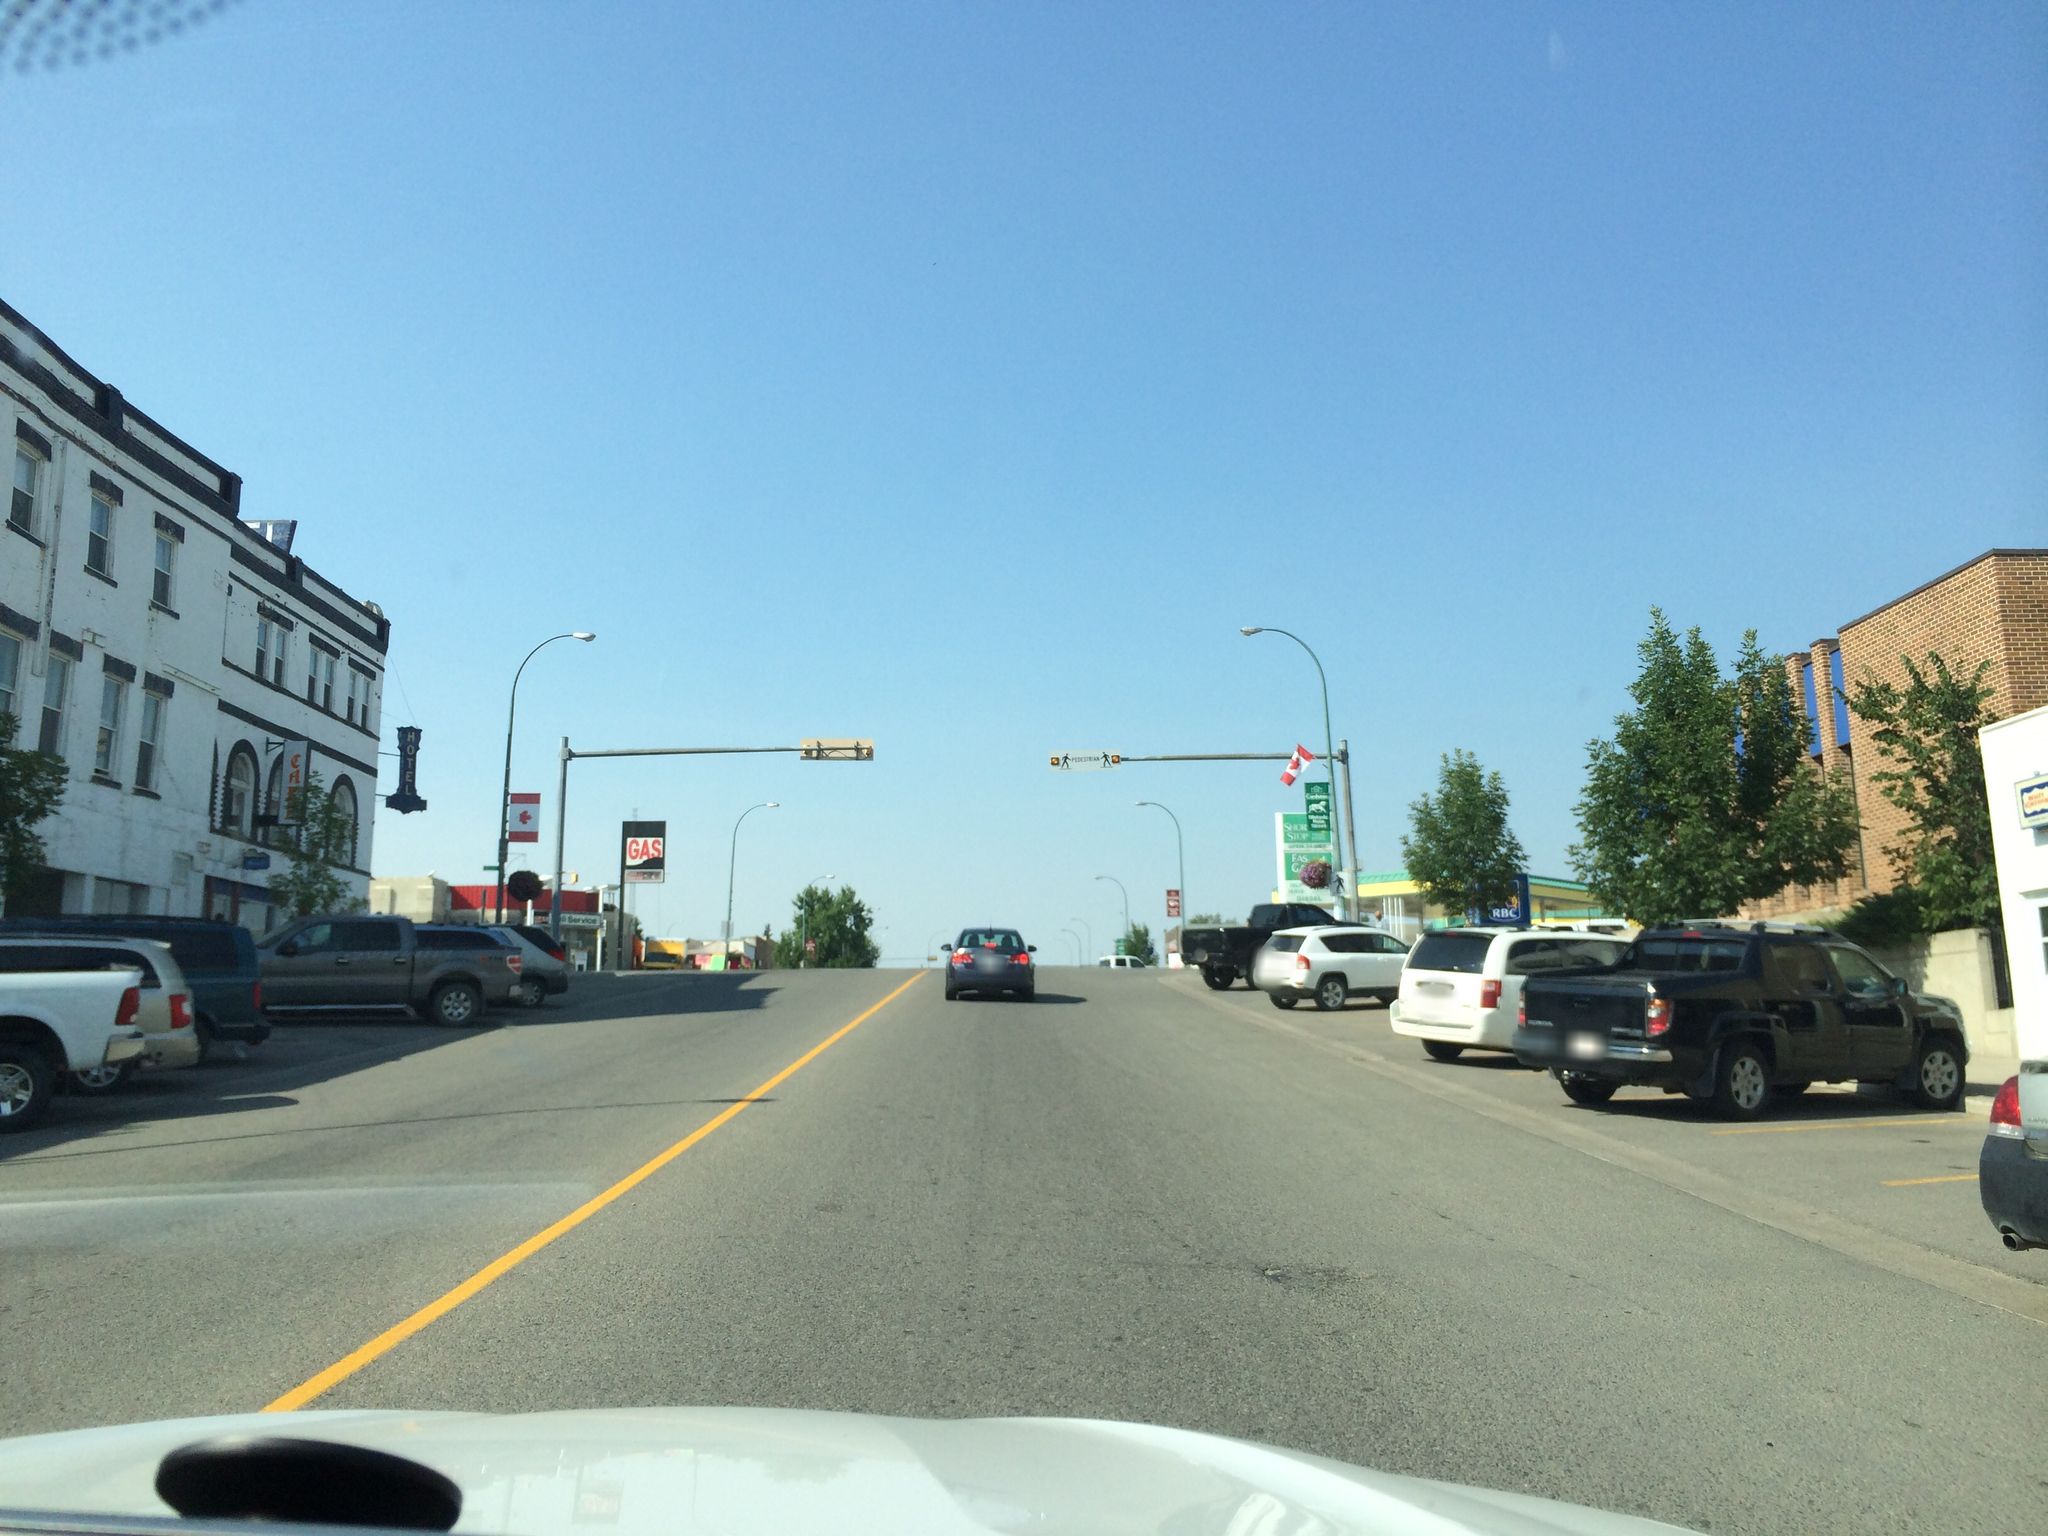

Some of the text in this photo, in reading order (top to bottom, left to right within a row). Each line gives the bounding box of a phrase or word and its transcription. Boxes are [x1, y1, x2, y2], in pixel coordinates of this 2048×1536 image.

[405, 732, 415, 795] HOTEL
[1284, 823, 1308, 831] SHOR
[628, 839, 662, 860] GAS
[1492, 908, 1517, 918] RBC
[568, 915, 597, 924] Service
